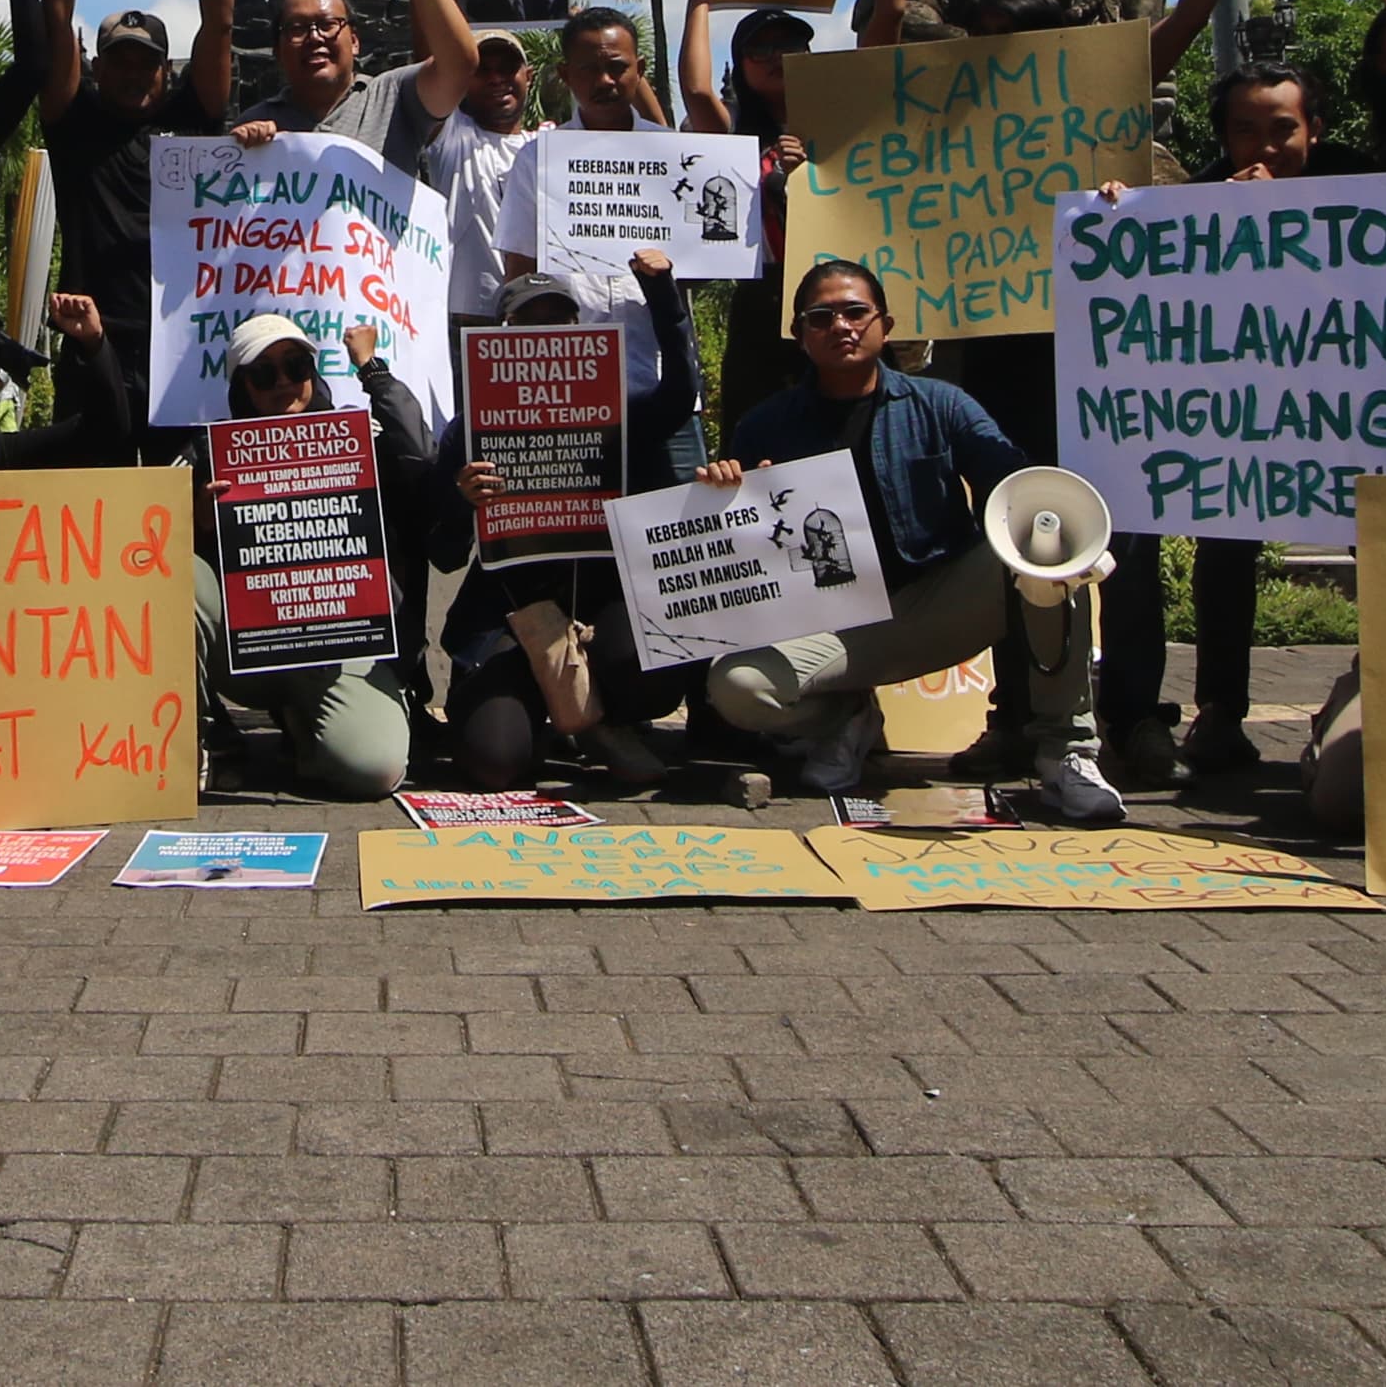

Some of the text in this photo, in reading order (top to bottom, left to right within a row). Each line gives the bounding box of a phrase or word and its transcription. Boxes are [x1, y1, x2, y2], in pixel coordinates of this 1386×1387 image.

[894, 47, 1070, 126] KAMI
[568, 159, 667, 175] KEBEBASAN PERS
[807, 126, 976, 196] LEBIH
[568, 181, 640, 196] ADALAH HAK
[867, 162, 1079, 236] TEMPO
[194, 169, 443, 271] KALAU ANTIKRITIK
[568, 202, 663, 220] ASASI MANUSIA,
[568, 224, 671, 241] JANGAN DIGUGAT!
[188, 217, 395, 281] TINGGAL SAJA
[947, 225, 1038, 280] PADA
[196, 262, 419, 338] DI DALAM GOA
[478, 335, 609, 359] SOLIDARITAS
[490, 359, 597, 383] JURNALIS
[518, 384, 571, 406] BALI
[480, 405, 611, 426] UNTUK TEMPO
[231, 420, 350, 448] SOLIDARITAS
[481, 432, 602, 449] BUKAN 200 MILIAR
[226, 437, 360, 466] UNTUK TEMPO
[519, 447, 604, 464] KAMI TAKUTI,
[237, 462, 363, 485] KALAU TEMPO BISA DIGUGAT,
[513, 463, 584, 476] HILANGNYA
[264, 475, 357, 495] SIAPA SELANJUTNYA?
[527, 475, 601, 490] KEBENARAN
[234, 495, 362, 525] TEMPO DIGUGAT,
[485, 499, 589, 518] KEBENARAN TAK
[254, 517, 349, 544] KEBENARAN
[487, 514, 577, 534] DITAGIH GANTI
[645, 506, 759, 544] KEBEBASAN PERS
[239, 536, 367, 566] DIPERTARUHKAN
[652, 538, 735, 570] ADALAH HAK
[246, 564, 373, 591] BERITA BUKAN DOSA,
[658, 559, 767, 595] ASASI MANUSIA,
[271, 582, 356, 605] KRITIK BUKAN
[665, 581, 781, 620] JANGAN DIGUGAT!
[277, 600, 346, 621] KEJAHATAN
[397, 830, 726, 846] JANGAN
[841, 837, 1220, 863] JANGAN
[508, 861, 783, 876] TEMPO
